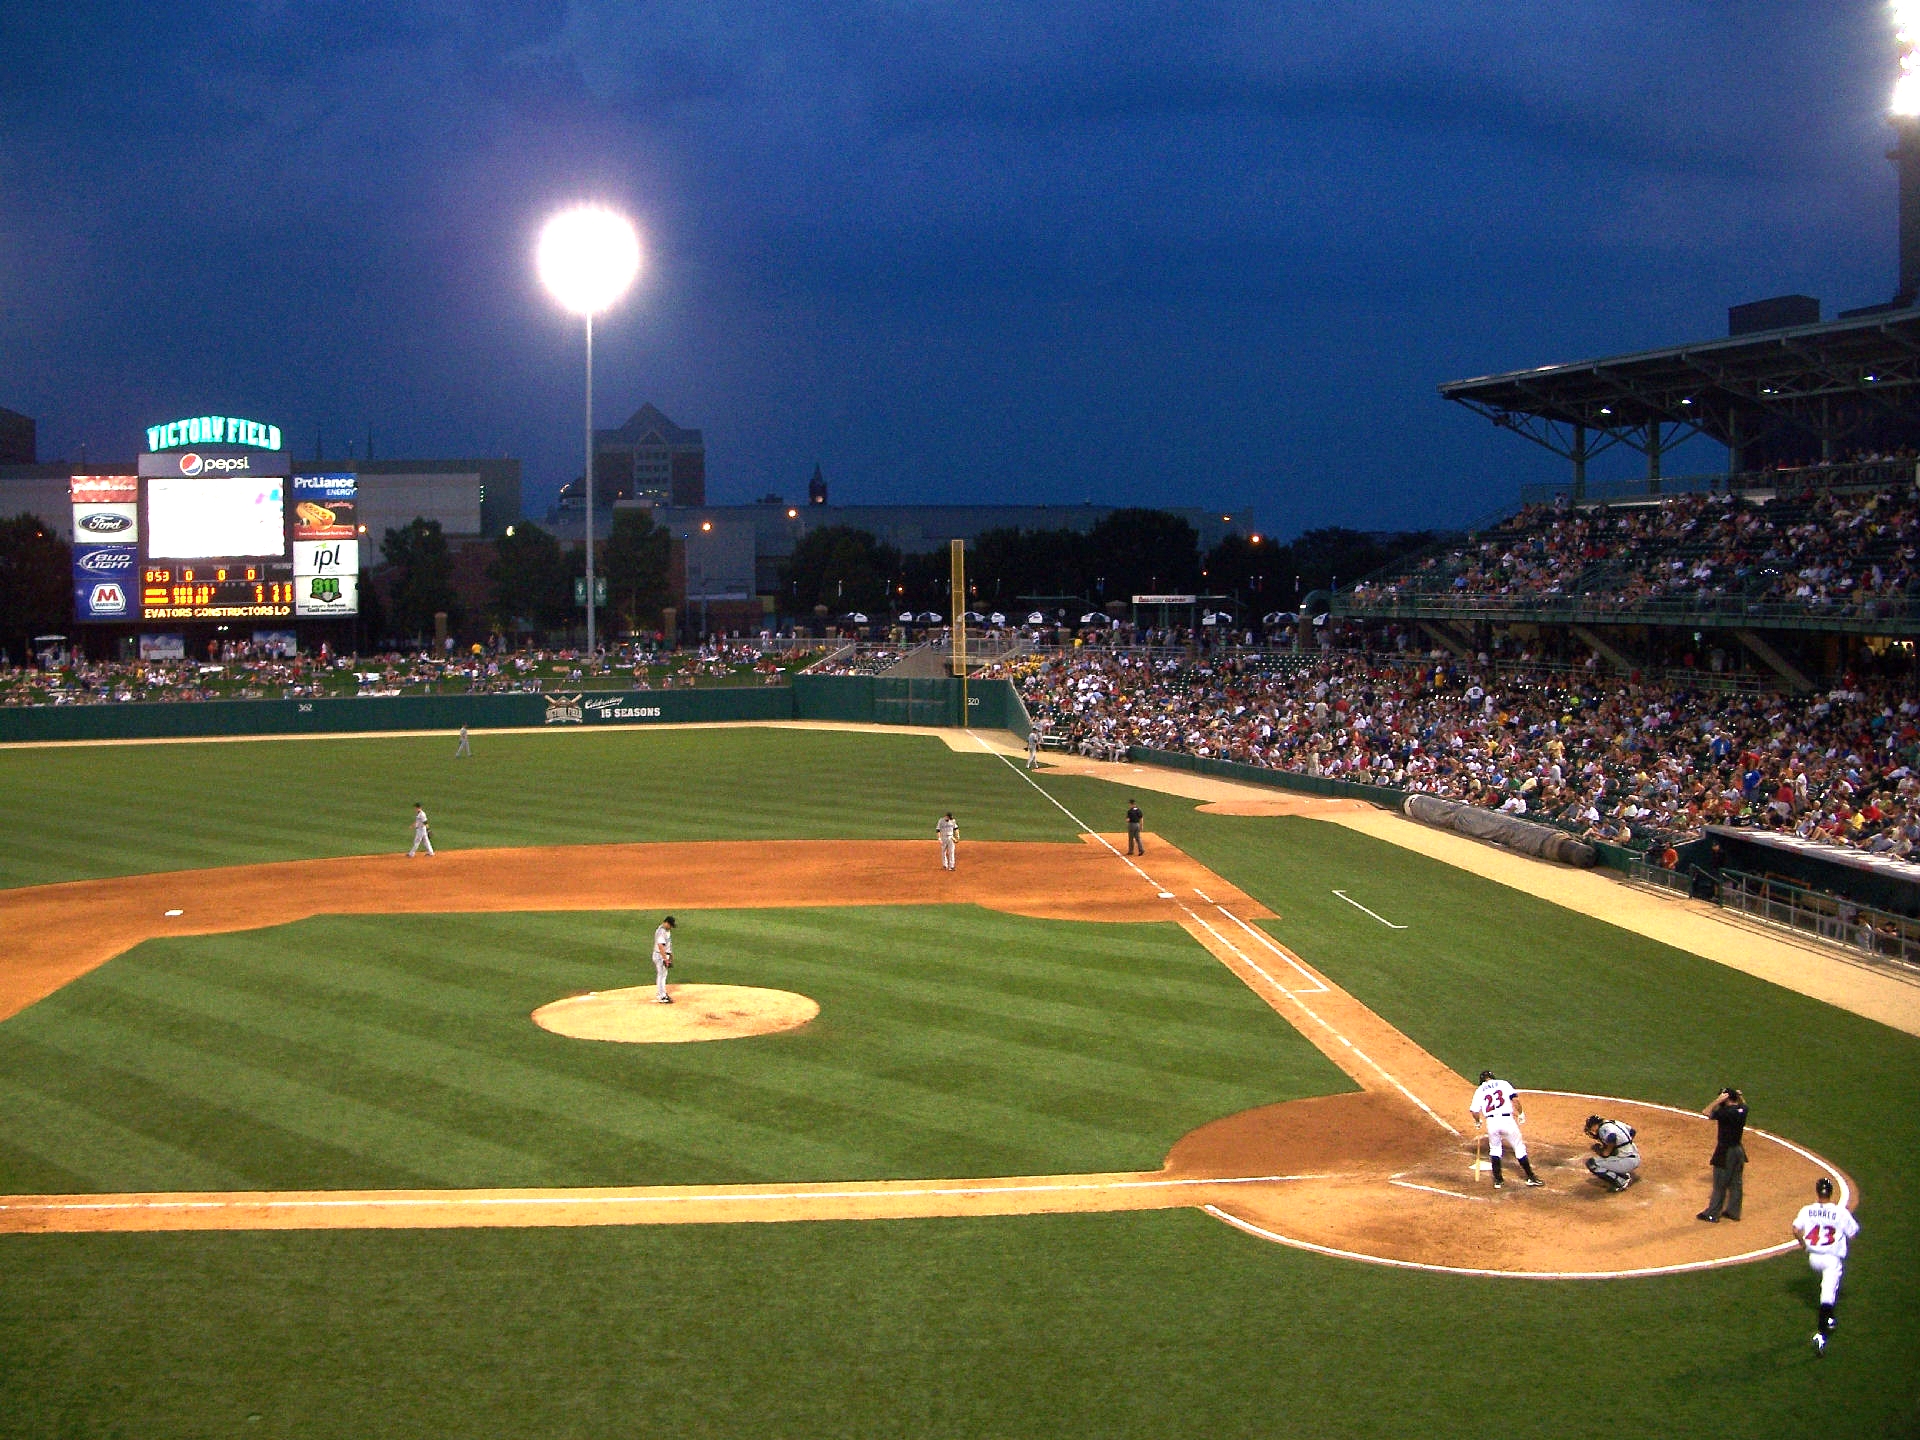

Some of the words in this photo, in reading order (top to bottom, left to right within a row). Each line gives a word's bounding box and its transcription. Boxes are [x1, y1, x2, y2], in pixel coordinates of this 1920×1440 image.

[147, 415, 225, 452] VICTORY
[227, 417, 281, 451] FIELD
[204, 456, 250, 472] pepsi
[294, 477, 355, 488] ProLiance
[326, 488, 356, 496] ENERGY
[89, 516, 122, 530] Ford
[87, 561, 133, 569] LIGHT
[314, 544, 341, 574] ipl
[194, 606, 274, 617] CONSTRUCTORS
[601, 708, 611, 718] 15
[614, 707, 660, 718] SEASONS
[1484, 1090, 1505, 1113] 23
[1805, 1225, 1836, 1246] 43
